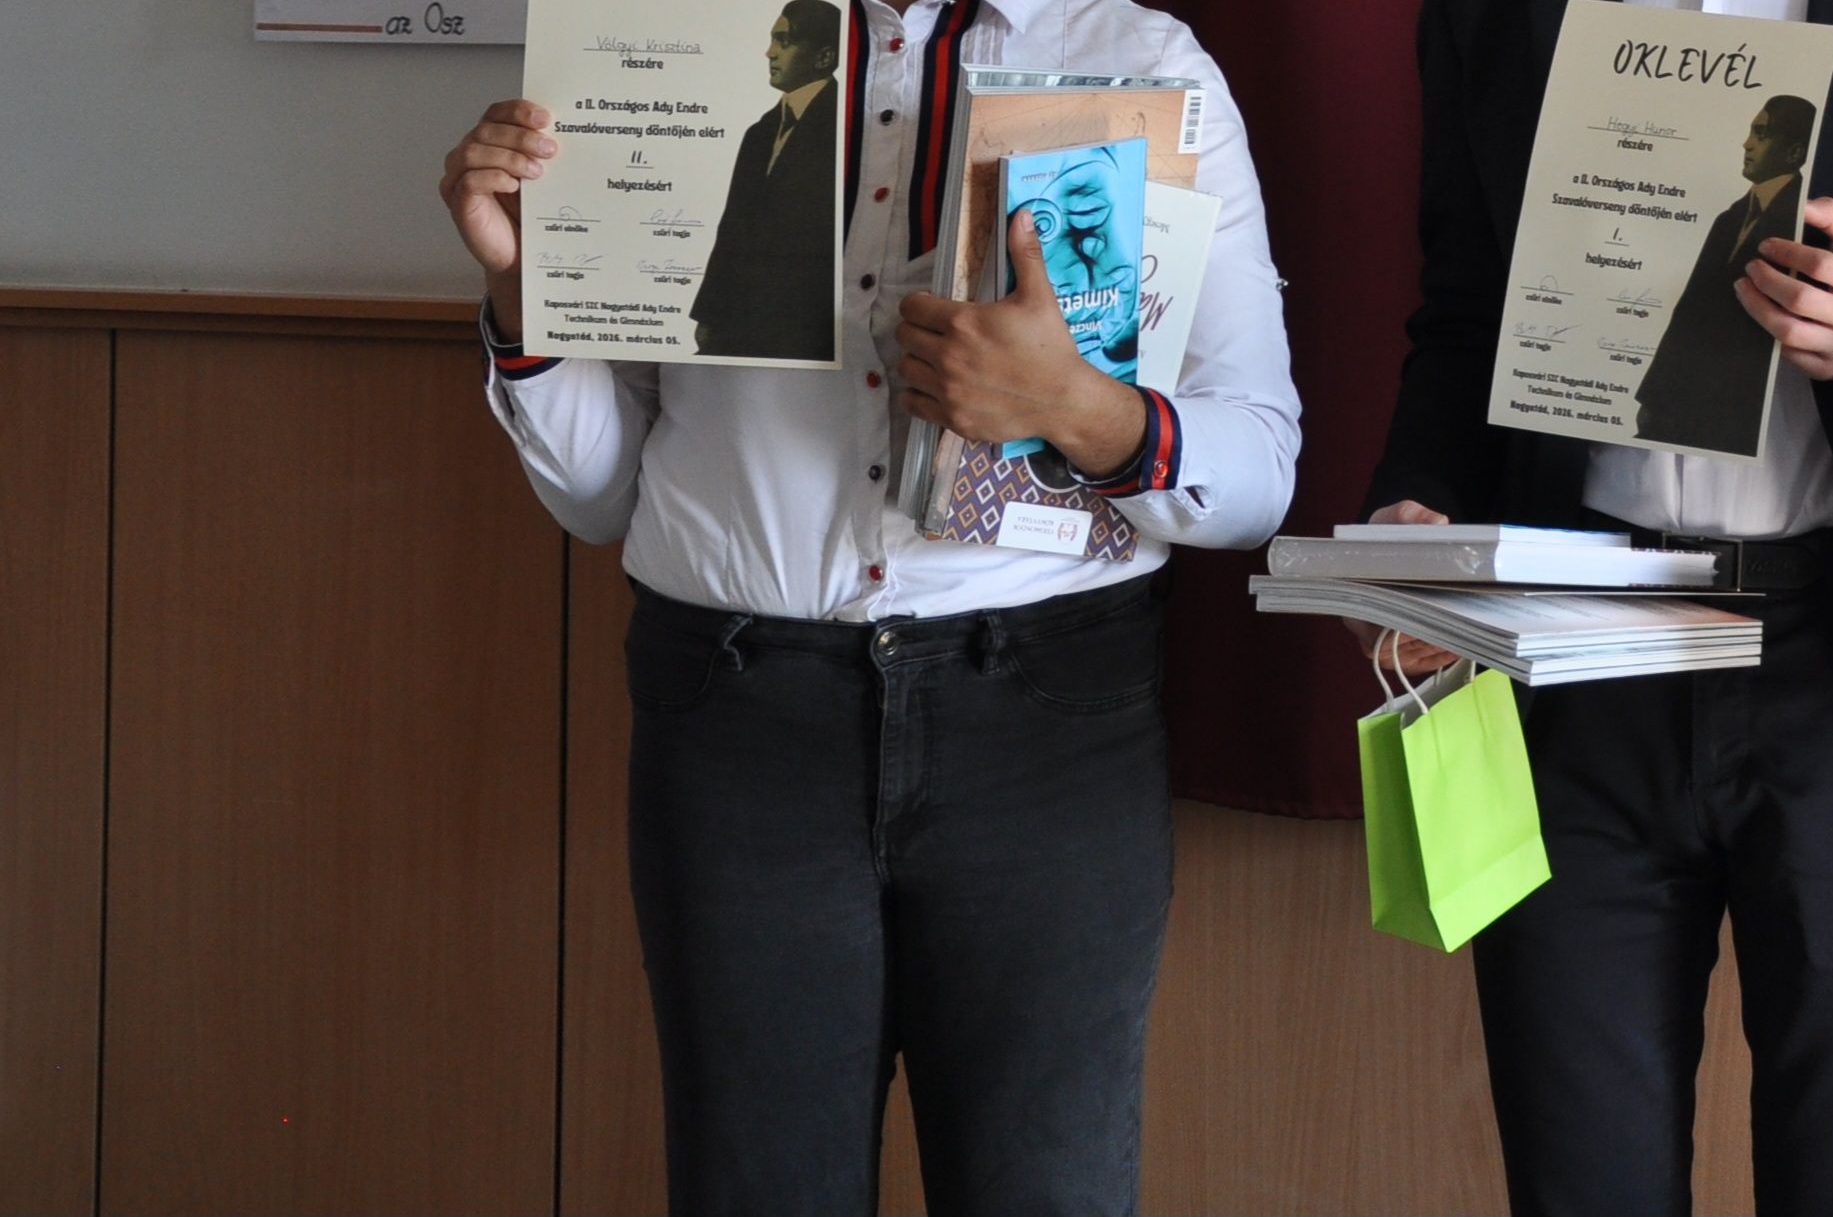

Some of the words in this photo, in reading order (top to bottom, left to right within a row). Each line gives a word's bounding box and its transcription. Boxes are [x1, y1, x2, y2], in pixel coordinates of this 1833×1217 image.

[386, 16, 413, 35] az
[621, 56, 663, 70] részére
[1613, 39, 1762, 89] OKLEVÉL
[575, 100, 583, 110] a
[585, 99, 595, 110] II.
[598, 99, 650, 114] Országos
[652, 101, 673, 115] Ady
[676, 102, 708, 114] Endre
[554, 121, 643, 138] Szavalóverseny
[645, 124, 696, 139] döntőjén
[698, 126, 725, 138] elért
[1617, 137, 1653, 152] részére
[630, 150, 648, 164] II.
[607, 178, 672, 192] helyezésért
[1573, 175, 1579, 184] a
[1591, 175, 1635, 192] Országos
[1637, 181, 1656, 196] Ady
[1658, 184, 1686, 198] Endre
[1552, 193, 1627, 215] Szavalóverseny
[1628, 202, 1673, 220] döntőjén
[1674, 209, 1698, 223] elért
[1613, 227, 1623, 241] I.
[1585, 252, 1643, 270] helyezésért
[544, 299, 583, 310] Kaposvári
[600, 301, 640, 313] Nagyatádi
[642, 304, 657, 314] Ady
[659, 304, 681, 314] Endre
[564, 314, 608, 324] Technikum
[609, 316, 618, 325] és
[619, 316, 664, 326] Gimnázium
[547, 331, 595, 342] Nagyatád,
[626, 334, 663, 344] március
[1595, 381, 1608, 392] Ady
[1609, 383, 1629, 394] Endre
[1565, 391, 1573, 400] és
[1510, 400, 1550, 415] Nagyatád,
[1577, 411, 1608, 424] március
